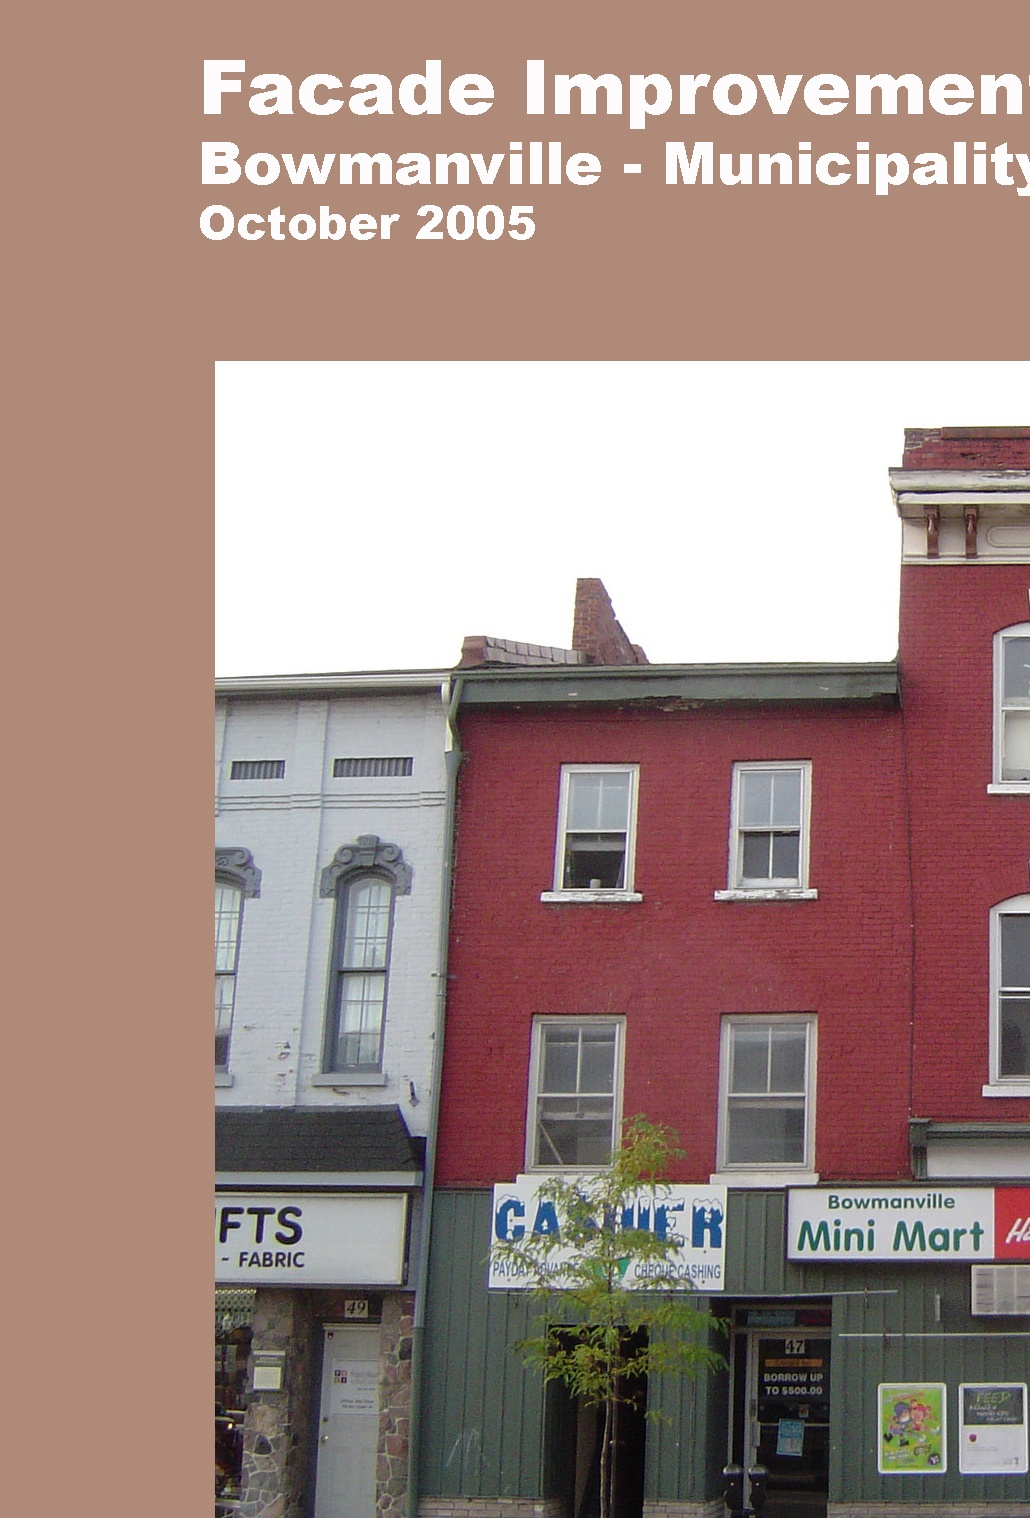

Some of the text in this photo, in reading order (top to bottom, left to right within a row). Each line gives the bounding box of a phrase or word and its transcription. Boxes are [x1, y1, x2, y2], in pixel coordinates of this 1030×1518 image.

[828, 1193, 956, 1210] Bowmanville
[215, 1206, 304, 1245] FTS
[495, 1193, 724, 1248] CAHIER
[797, 1218, 985, 1252] Mini Mart
[238, 1251, 305, 1268] FABRIC
[677, 1264, 722, 1280] CASHING
[346, 1301, 367, 1315] 49
[785, 1340, 804, 1353] 47
[763, 1373, 824, 1382] BORROW UP
[765, 1386, 823, 1395] TO $500.00
